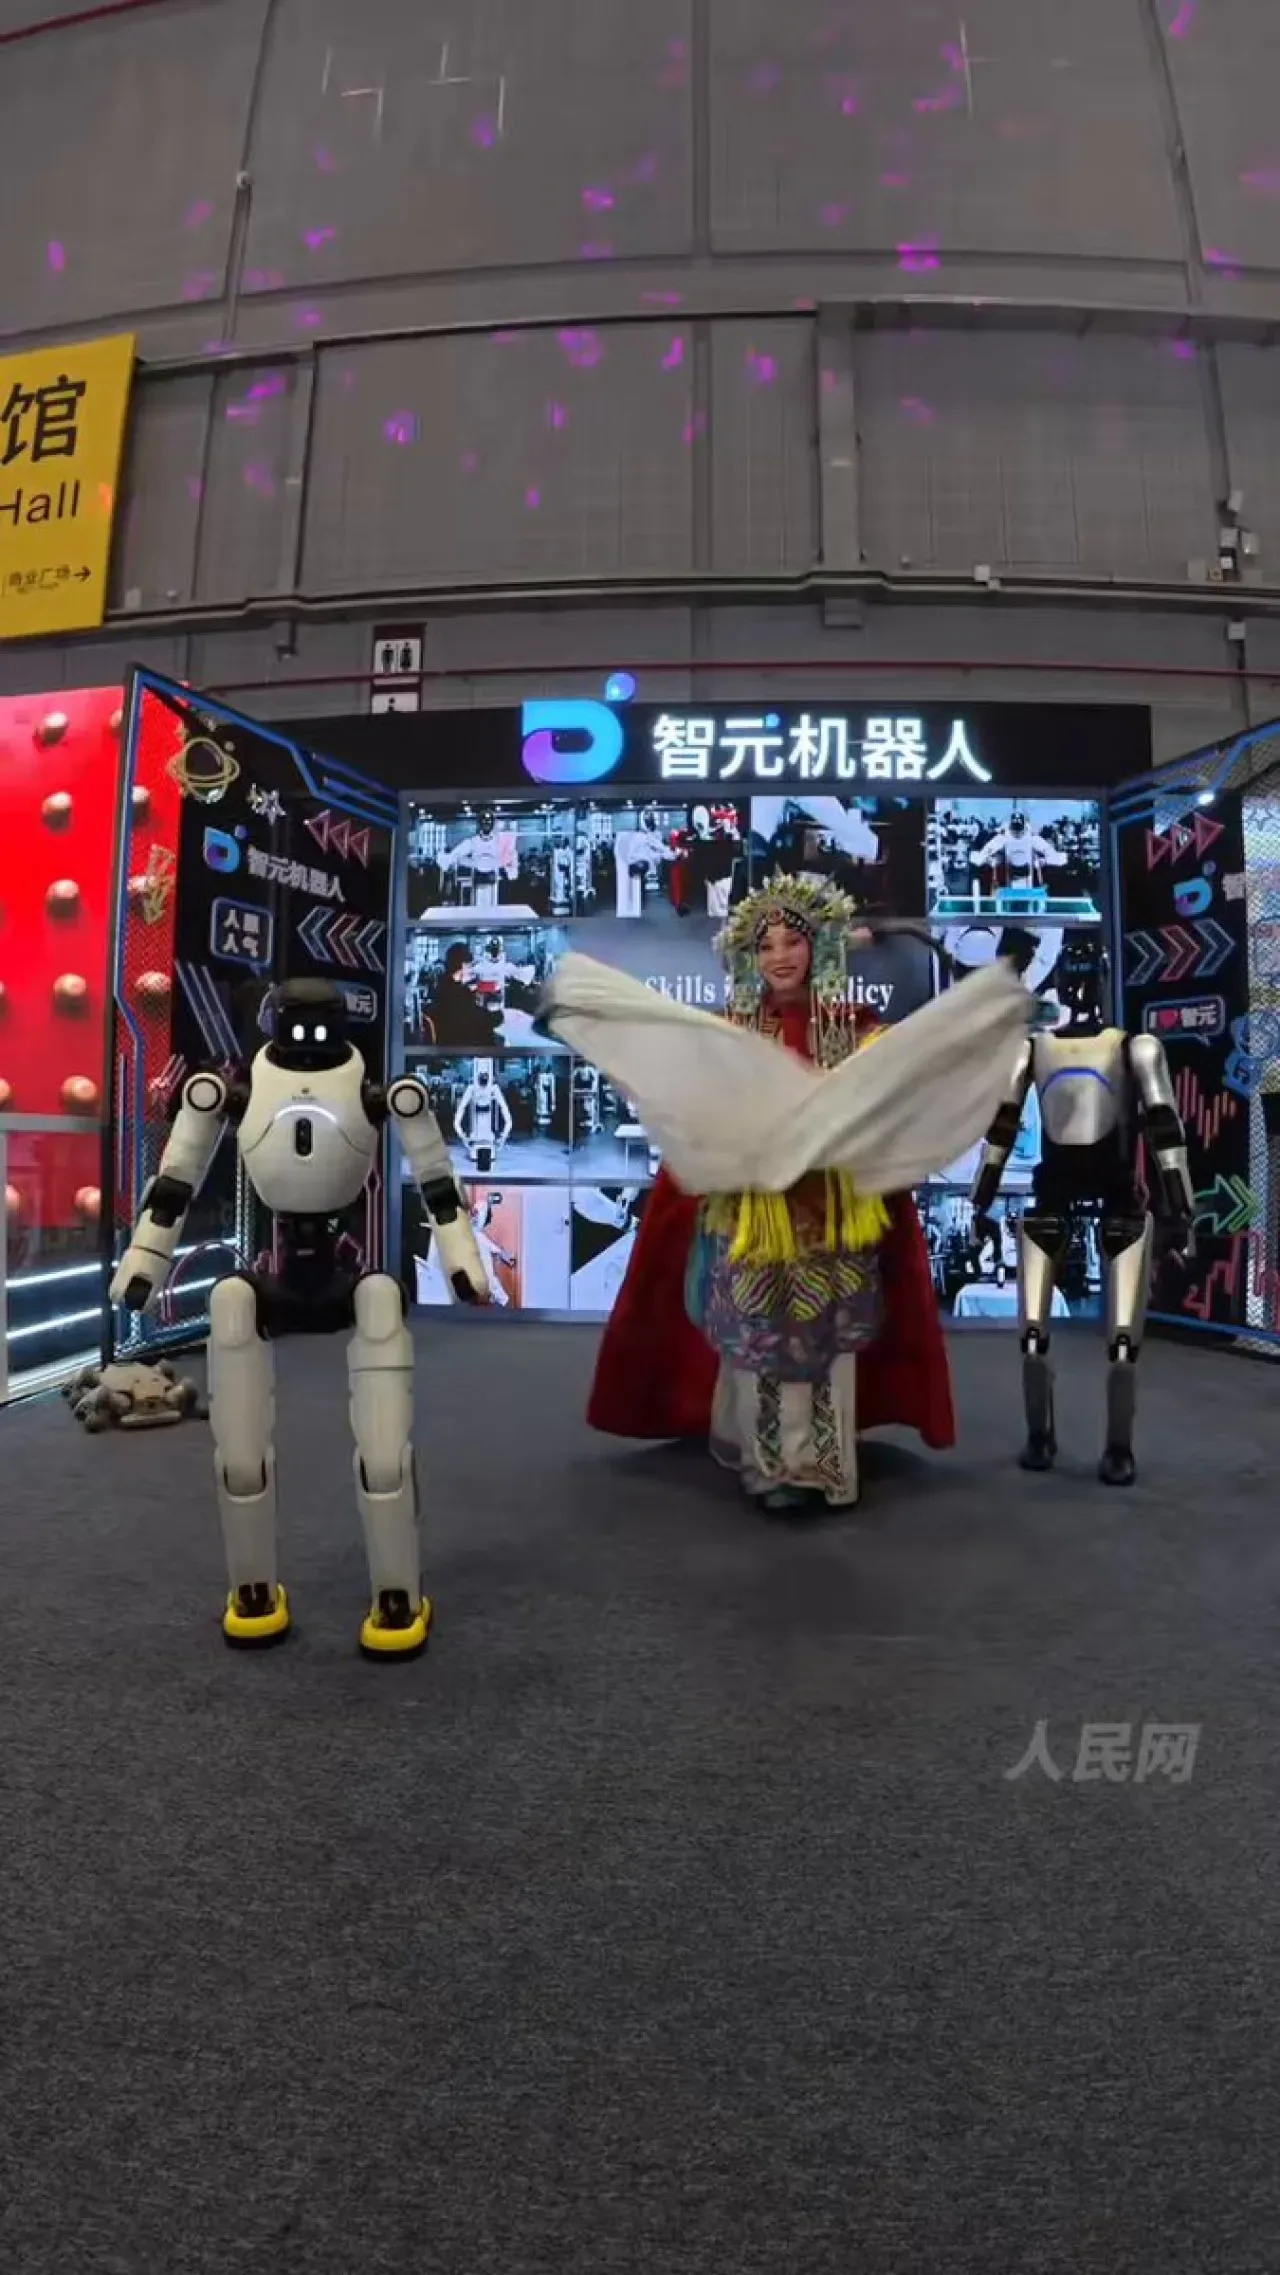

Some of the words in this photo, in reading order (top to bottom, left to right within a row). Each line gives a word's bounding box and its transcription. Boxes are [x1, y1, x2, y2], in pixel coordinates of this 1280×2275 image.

[0, 373, 87, 466] 馆
[0, 479, 80, 526] Hall
[652, 713, 993, 782] 智元机器人
[247, 844, 346, 903] 智元机器人
